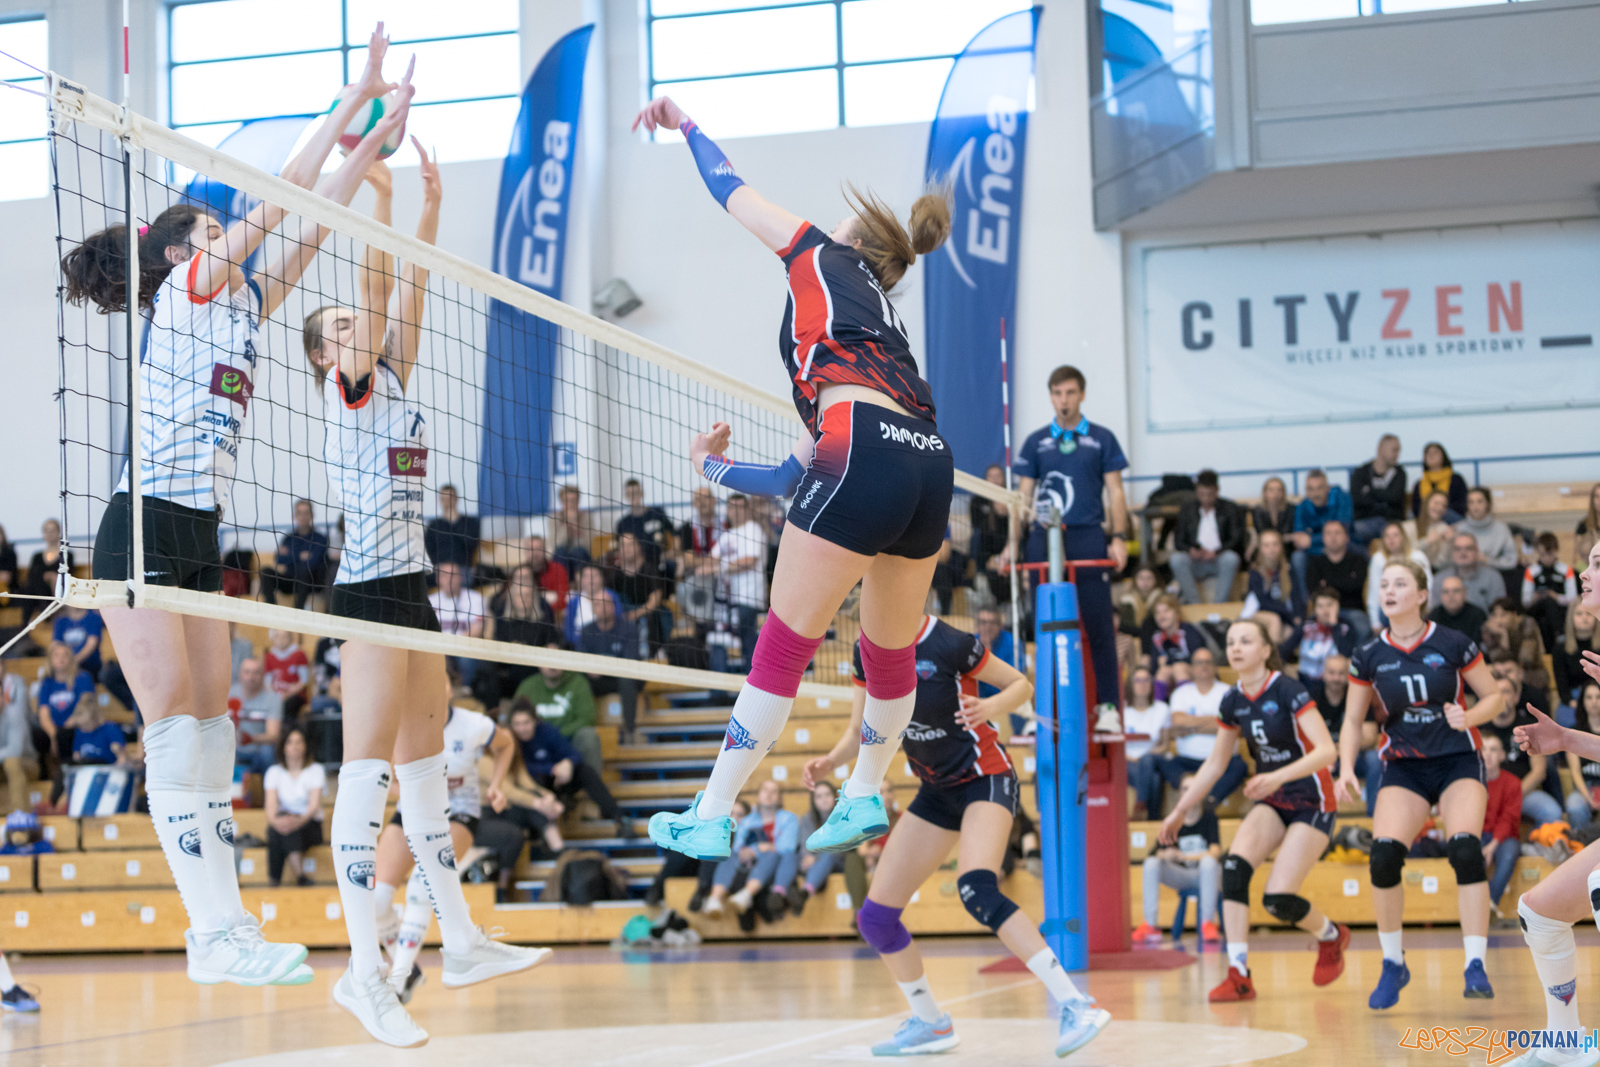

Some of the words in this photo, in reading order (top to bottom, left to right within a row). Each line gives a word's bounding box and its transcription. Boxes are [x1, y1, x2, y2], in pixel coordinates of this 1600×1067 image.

[967, 95, 1019, 264] Enea
[519, 119, 571, 288] Enea
[1181, 281, 1524, 351] CITYZEN
[1385, 342, 1428, 359] KLUB
[1436, 337, 1525, 355] SPORTOWY
[1400, 673, 1428, 704] 11
[906, 727, 948, 742] Enea
[1251, 719, 1269, 745] 5
